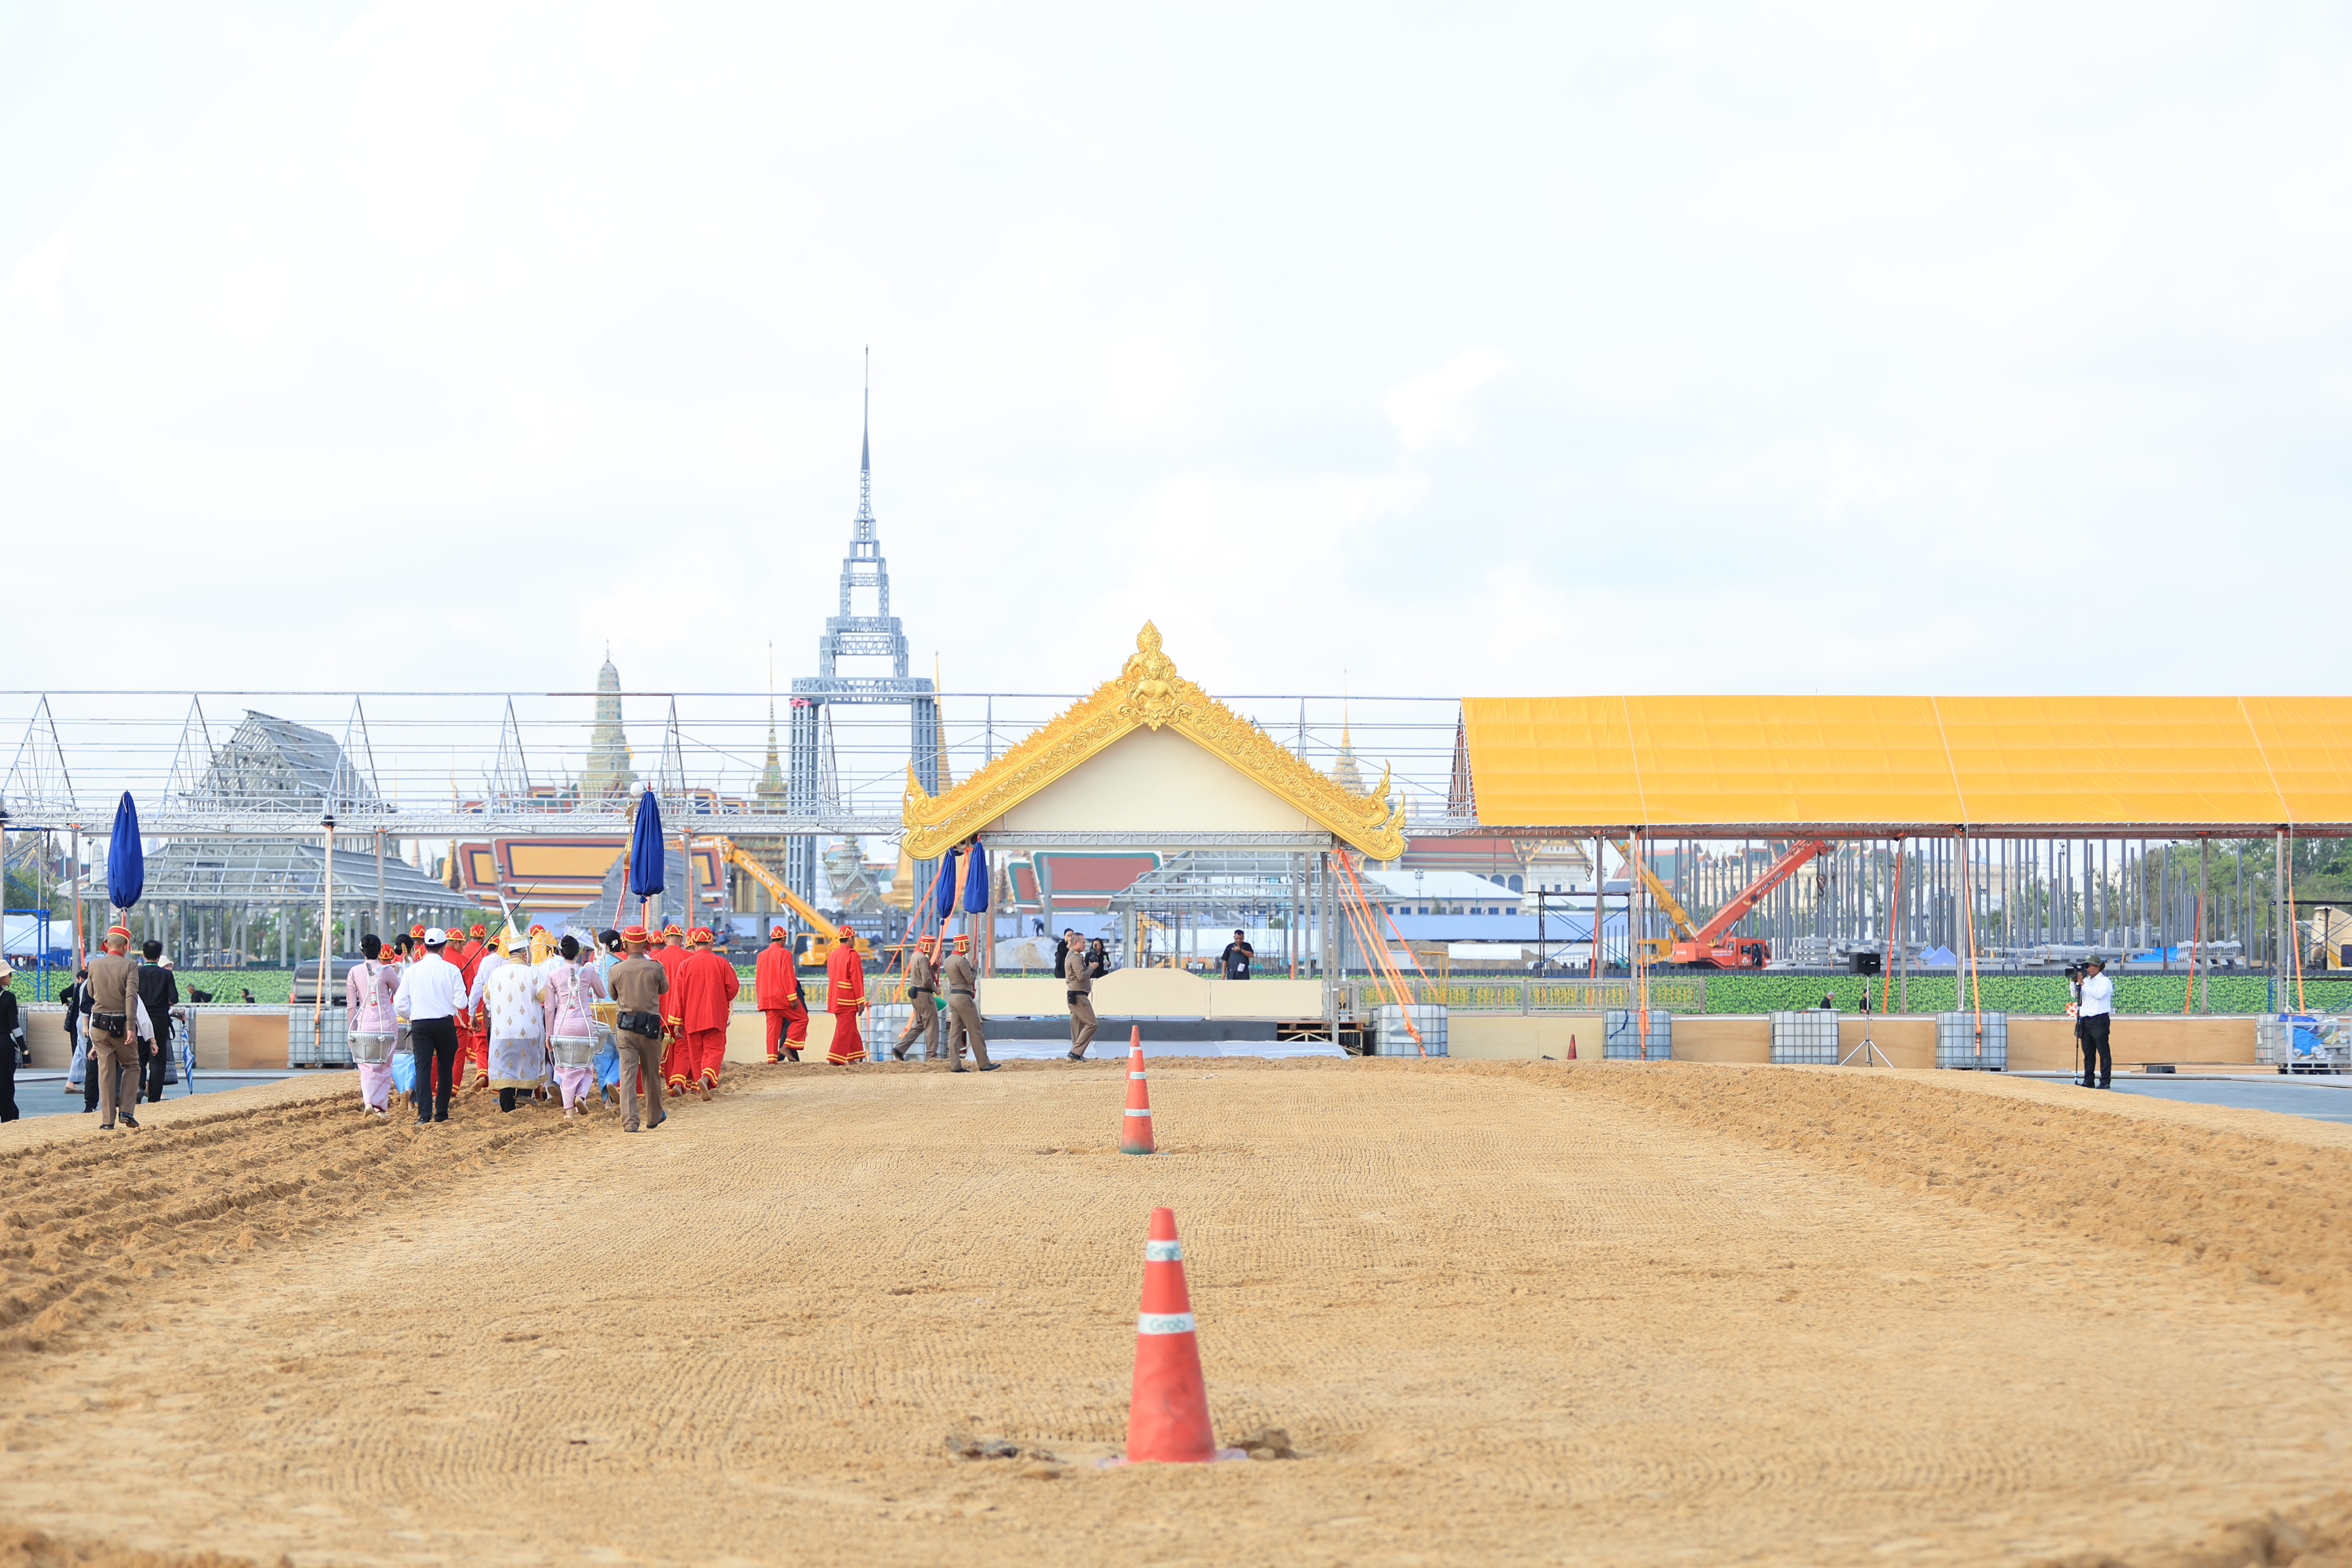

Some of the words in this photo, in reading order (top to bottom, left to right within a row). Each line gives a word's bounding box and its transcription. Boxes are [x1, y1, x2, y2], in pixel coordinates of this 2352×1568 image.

[756, 870, 774, 887] CRANE
[1774, 870, 1785, 881] THON
[1148, 1245, 1181, 1259] Grab
[1151, 1318, 1185, 1331] Grab
